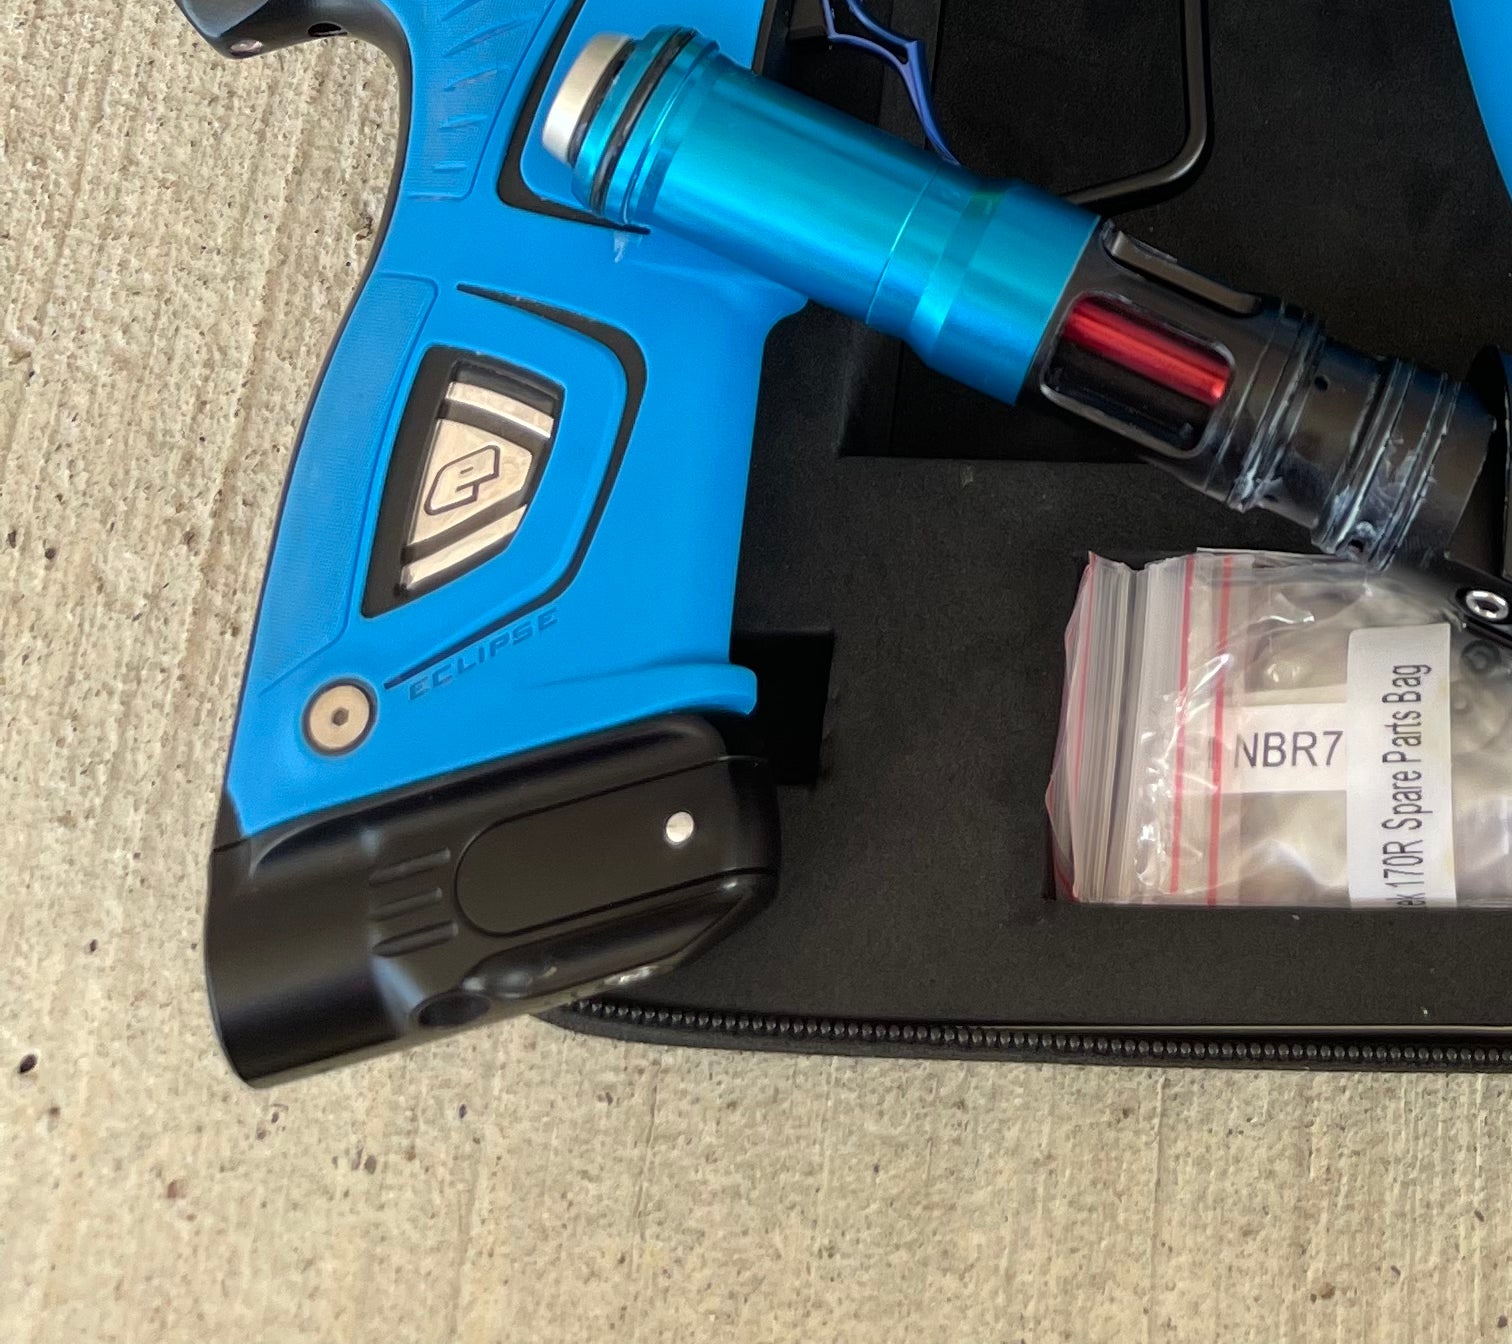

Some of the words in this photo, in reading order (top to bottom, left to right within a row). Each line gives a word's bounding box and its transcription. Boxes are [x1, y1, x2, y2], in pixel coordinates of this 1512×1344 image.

[407, 607, 559, 702] ECLIPSE
[1381, 664, 1432, 703] Bag
[1382, 710, 1422, 763] Parts
[1381, 770, 1433, 830] Spare
[1382, 840, 1425, 887] 170R
